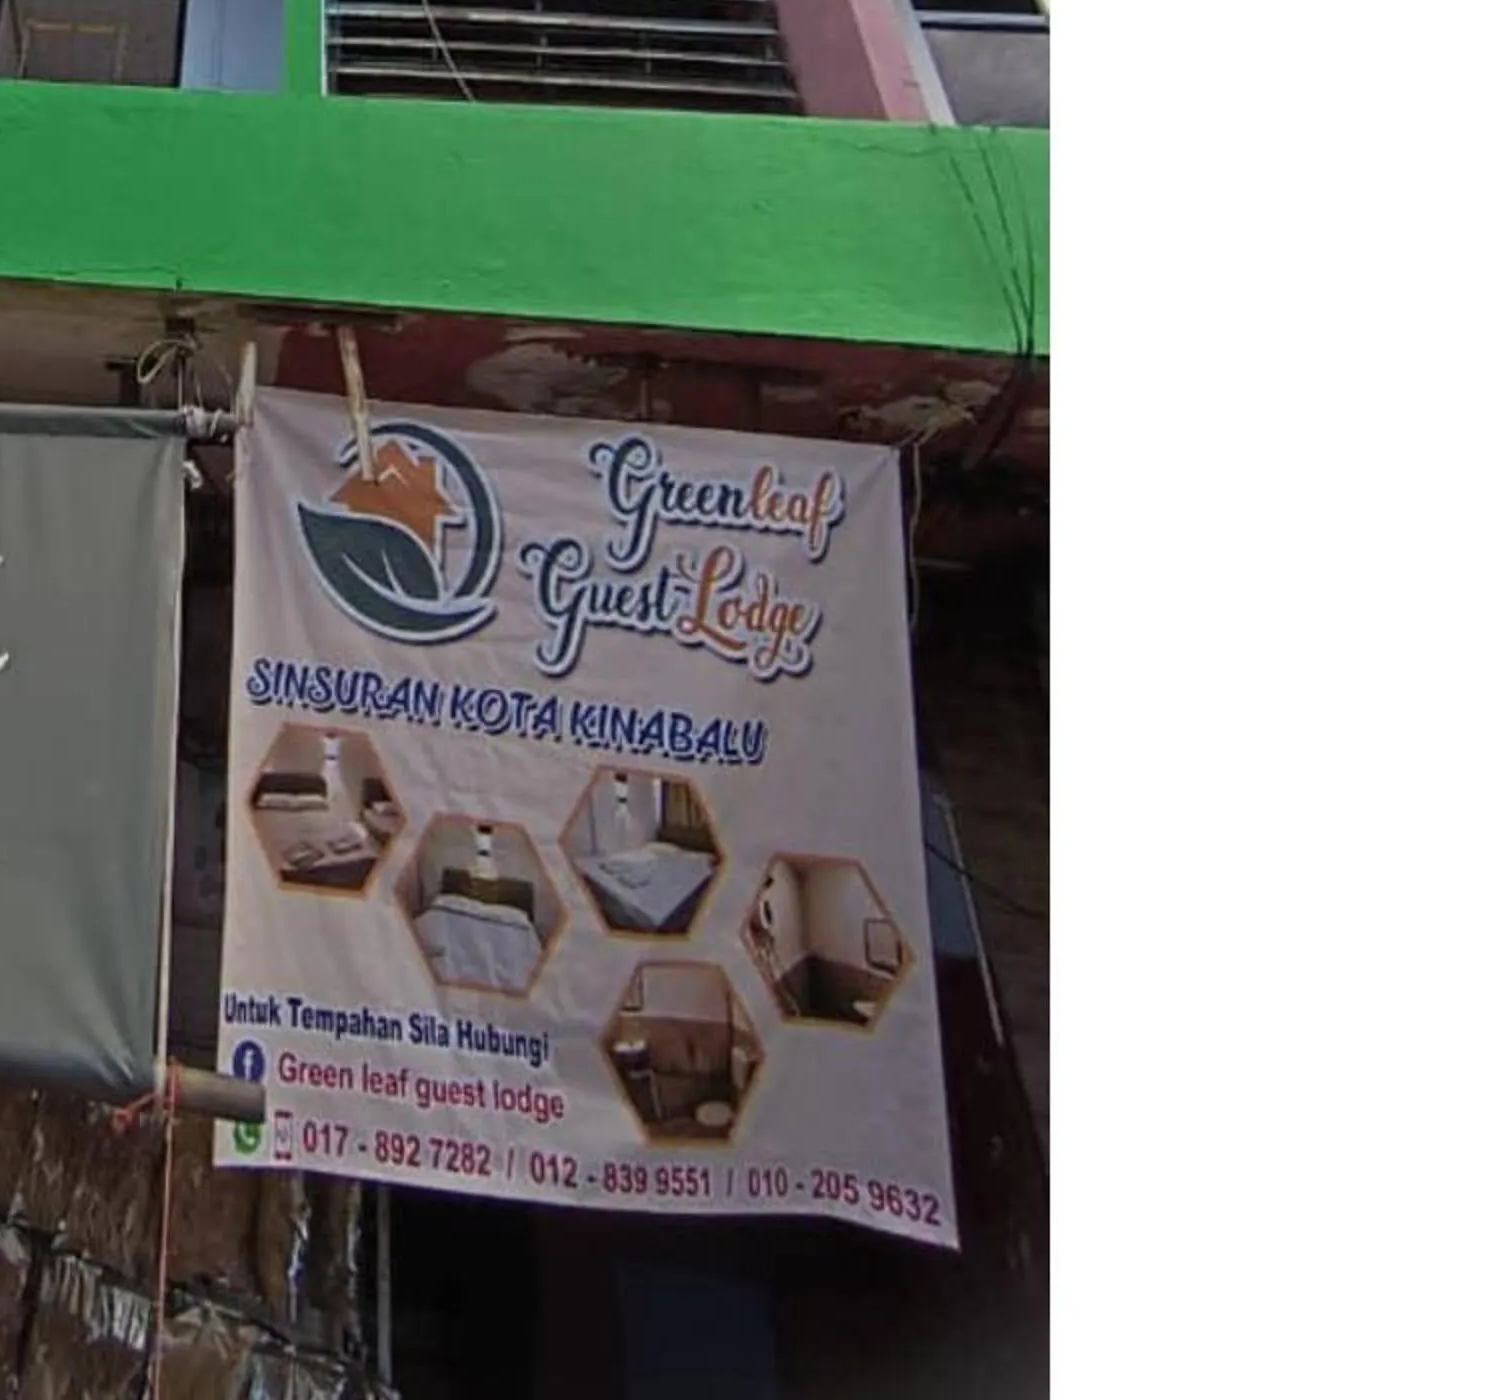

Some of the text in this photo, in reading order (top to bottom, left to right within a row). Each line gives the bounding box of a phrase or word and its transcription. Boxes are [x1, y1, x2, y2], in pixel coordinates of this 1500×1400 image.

[587, 436, 836, 564] Greenleaf
[675, 545, 809, 669] Lodge
[246, 657, 766, 763] SINSURAN KOTA KINABALU
[224, 993, 549, 1068] Untuk Tempahan Sila Hubungi
[278, 1050, 354, 1089] Green
[361, 1061, 409, 1097] leaf
[415, 1076, 486, 1109] guest
[492, 1079, 565, 1124] lodge
[303, 1119, 349, 1157] 017
[374, 1129, 421, 1167] 892
[429, 1137, 492, 1176] 7282
[530, 1151, 577, 1188] 012
[603, 1162, 647, 1194] 839
[655, 1166, 711, 1197] 9551
[748, 1166, 788, 1197] 010
[811, 1168, 860, 1205] 205
[867, 1179, 942, 1227] 9632
